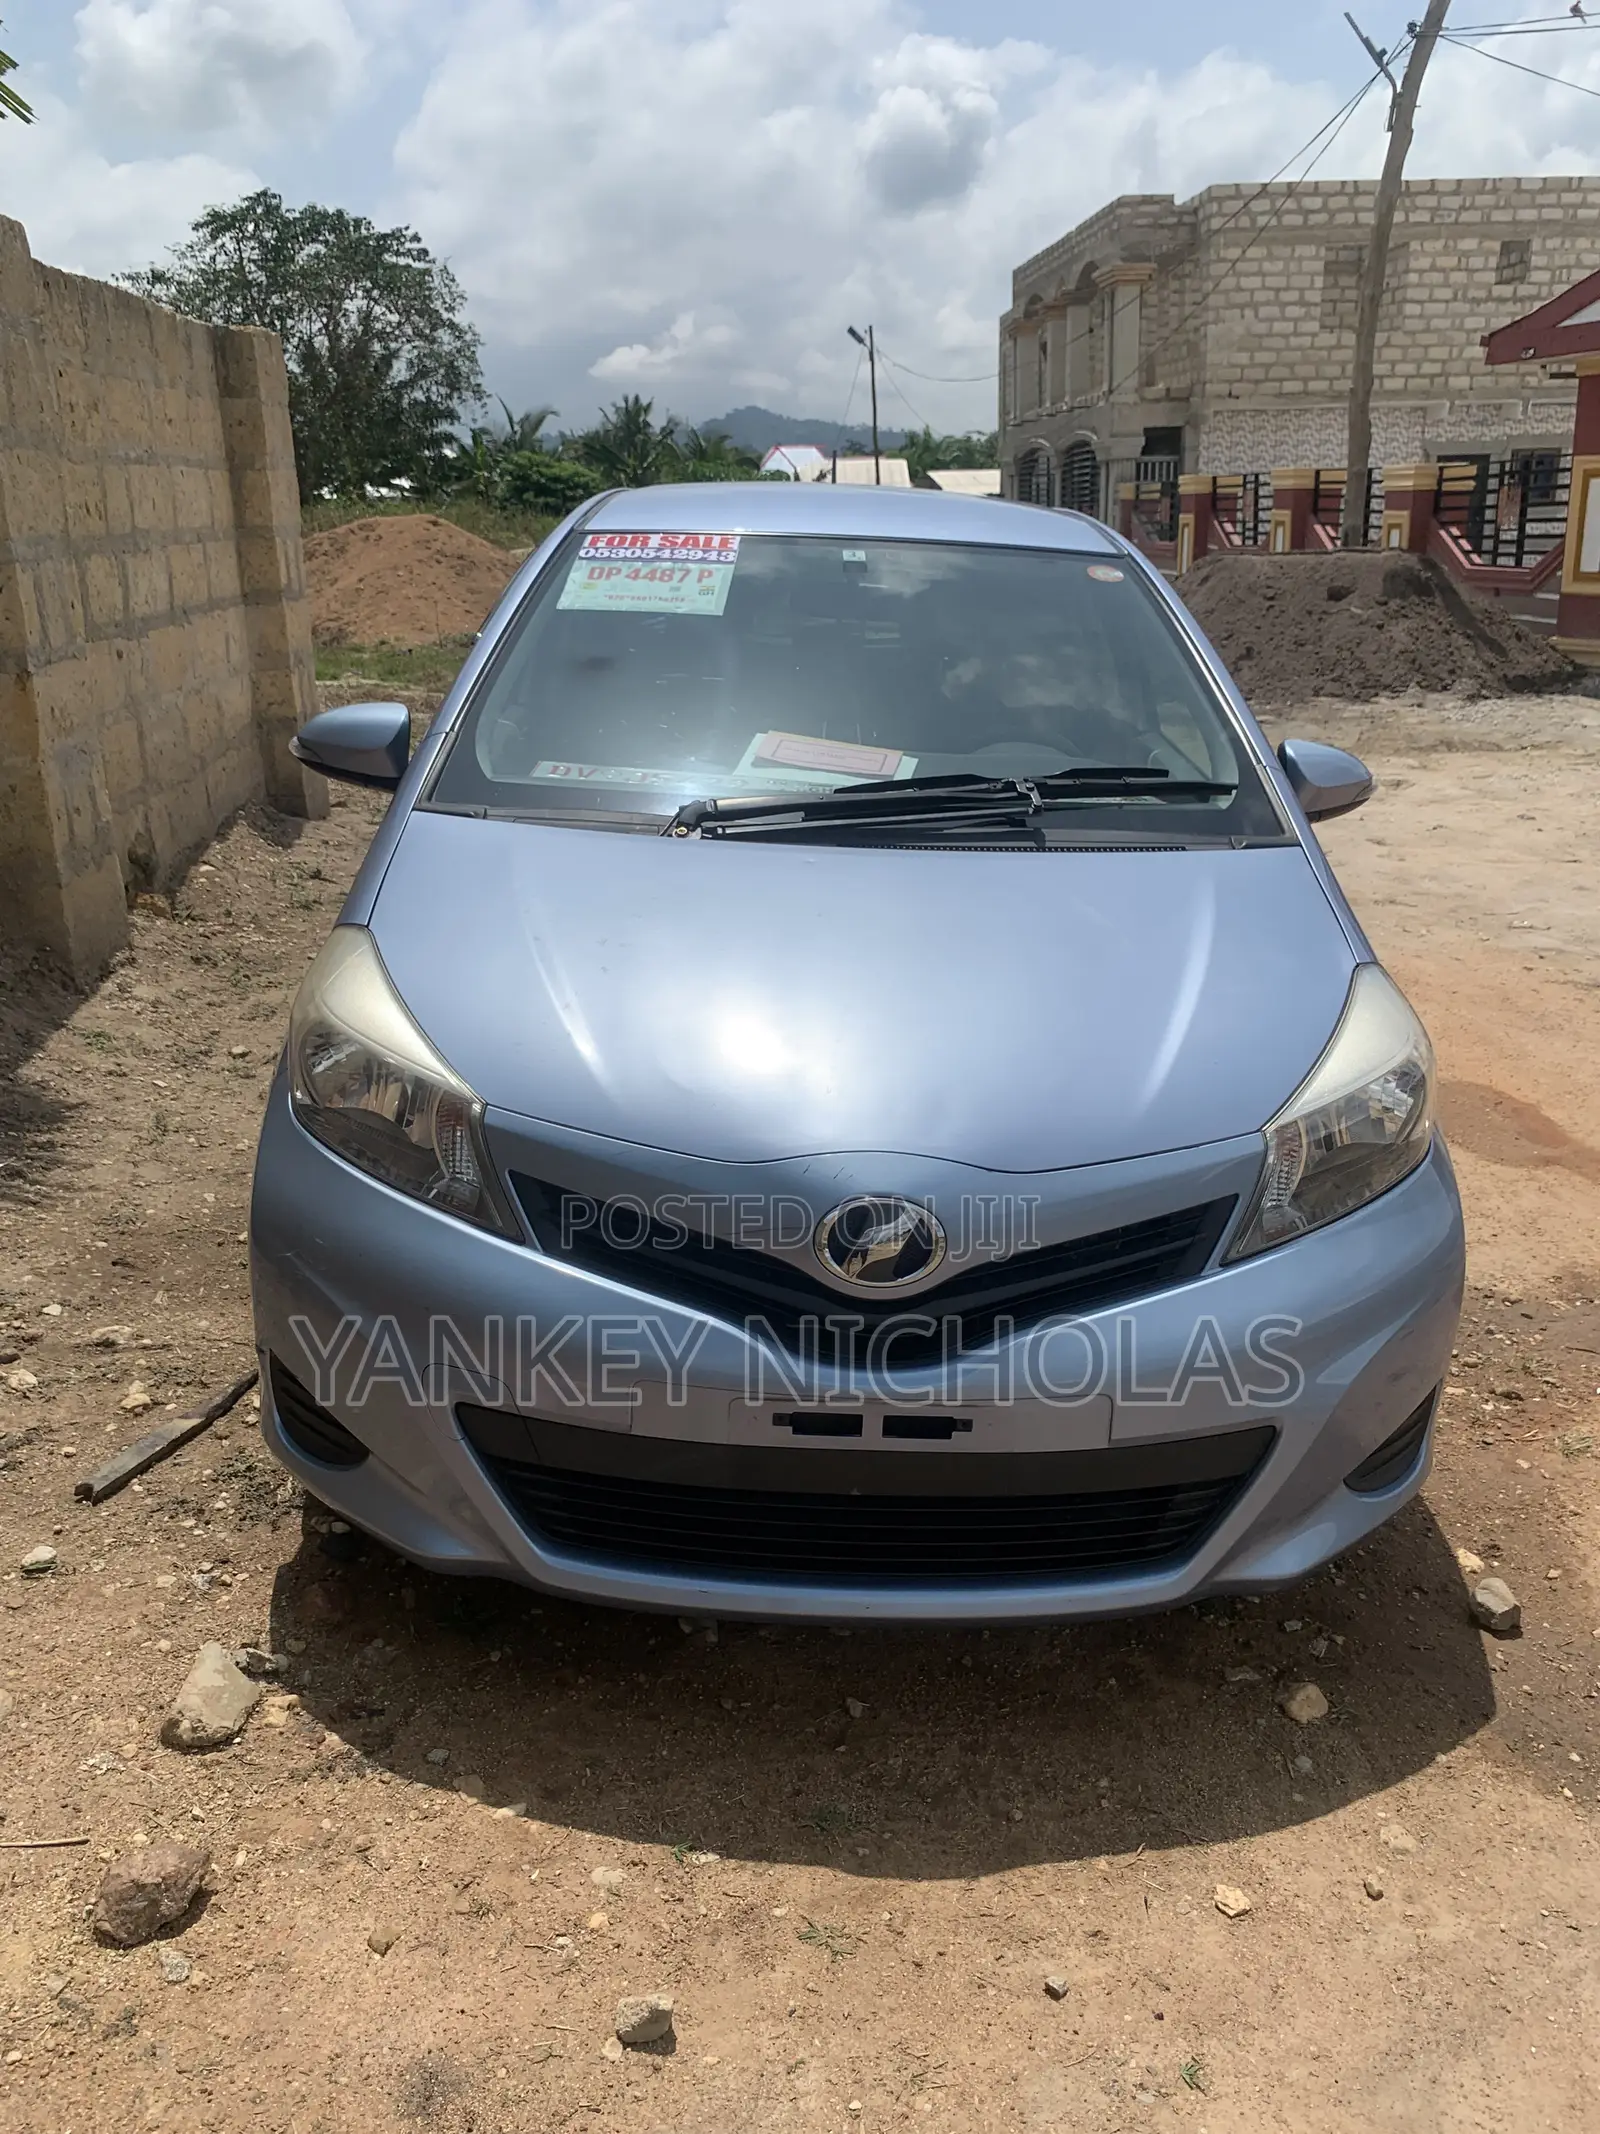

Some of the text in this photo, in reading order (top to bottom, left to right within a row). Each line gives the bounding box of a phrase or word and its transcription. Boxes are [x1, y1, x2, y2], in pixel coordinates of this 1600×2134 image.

[588, 534, 736, 549] FOR SALE
[578, 548, 736, 562] 0530542943
[587, 566, 713, 584] DP 4487 P
